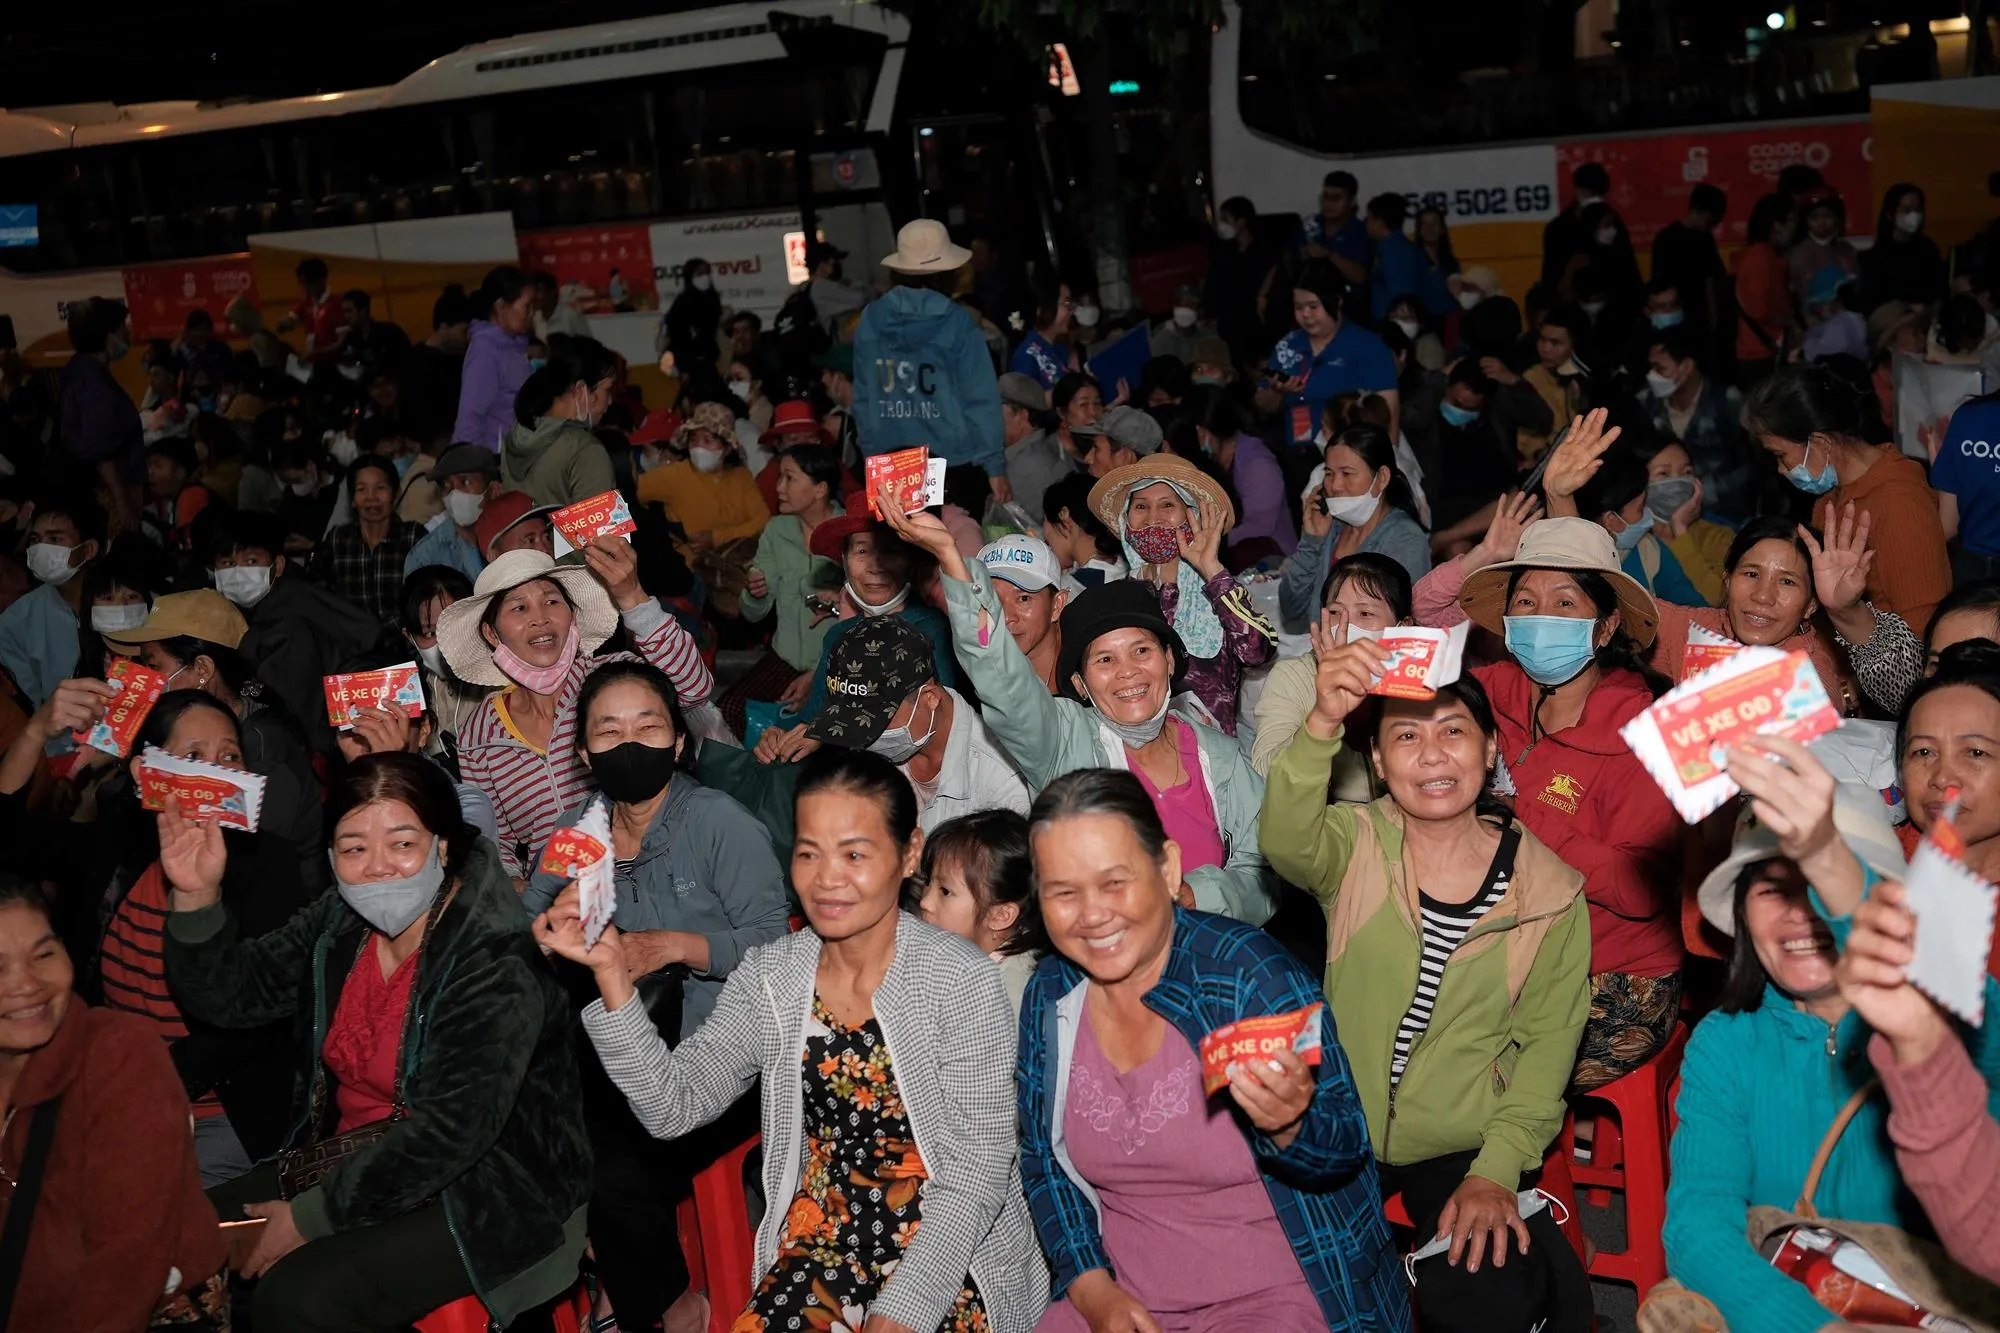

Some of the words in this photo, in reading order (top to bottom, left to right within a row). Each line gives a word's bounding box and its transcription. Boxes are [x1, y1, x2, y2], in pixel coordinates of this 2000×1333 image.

[875, 358, 936, 395] USC
[878, 400, 940, 419] TROJANS
[572, 517, 587, 530] XE
[826, 675, 868, 696] adidas
[121, 691, 139, 708] XE
[331, 687, 349, 702] VÉ
[351, 687, 369, 700] XE
[1704, 706, 1738, 735] XE
[148, 781, 168, 793] VÉ
[1536, 791, 1578, 816] BURBERRY
[554, 842, 576, 857] VÉ
[1231, 1038, 1257, 1055] XE
